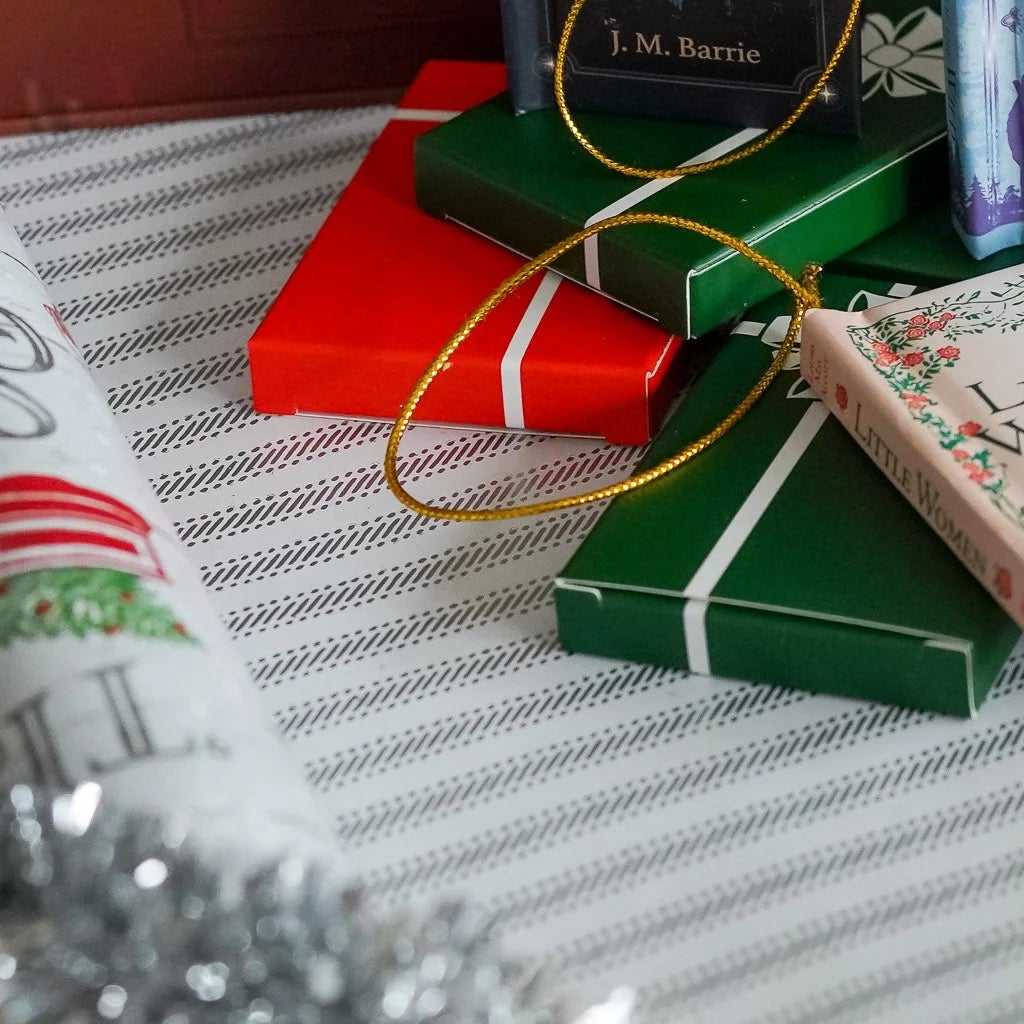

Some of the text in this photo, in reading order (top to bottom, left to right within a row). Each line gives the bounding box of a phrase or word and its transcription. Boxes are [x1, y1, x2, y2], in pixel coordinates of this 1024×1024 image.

[610, 29, 762, 65] J. M. Barrie
[853, 400, 987, 578] LITTLE WOMEN
